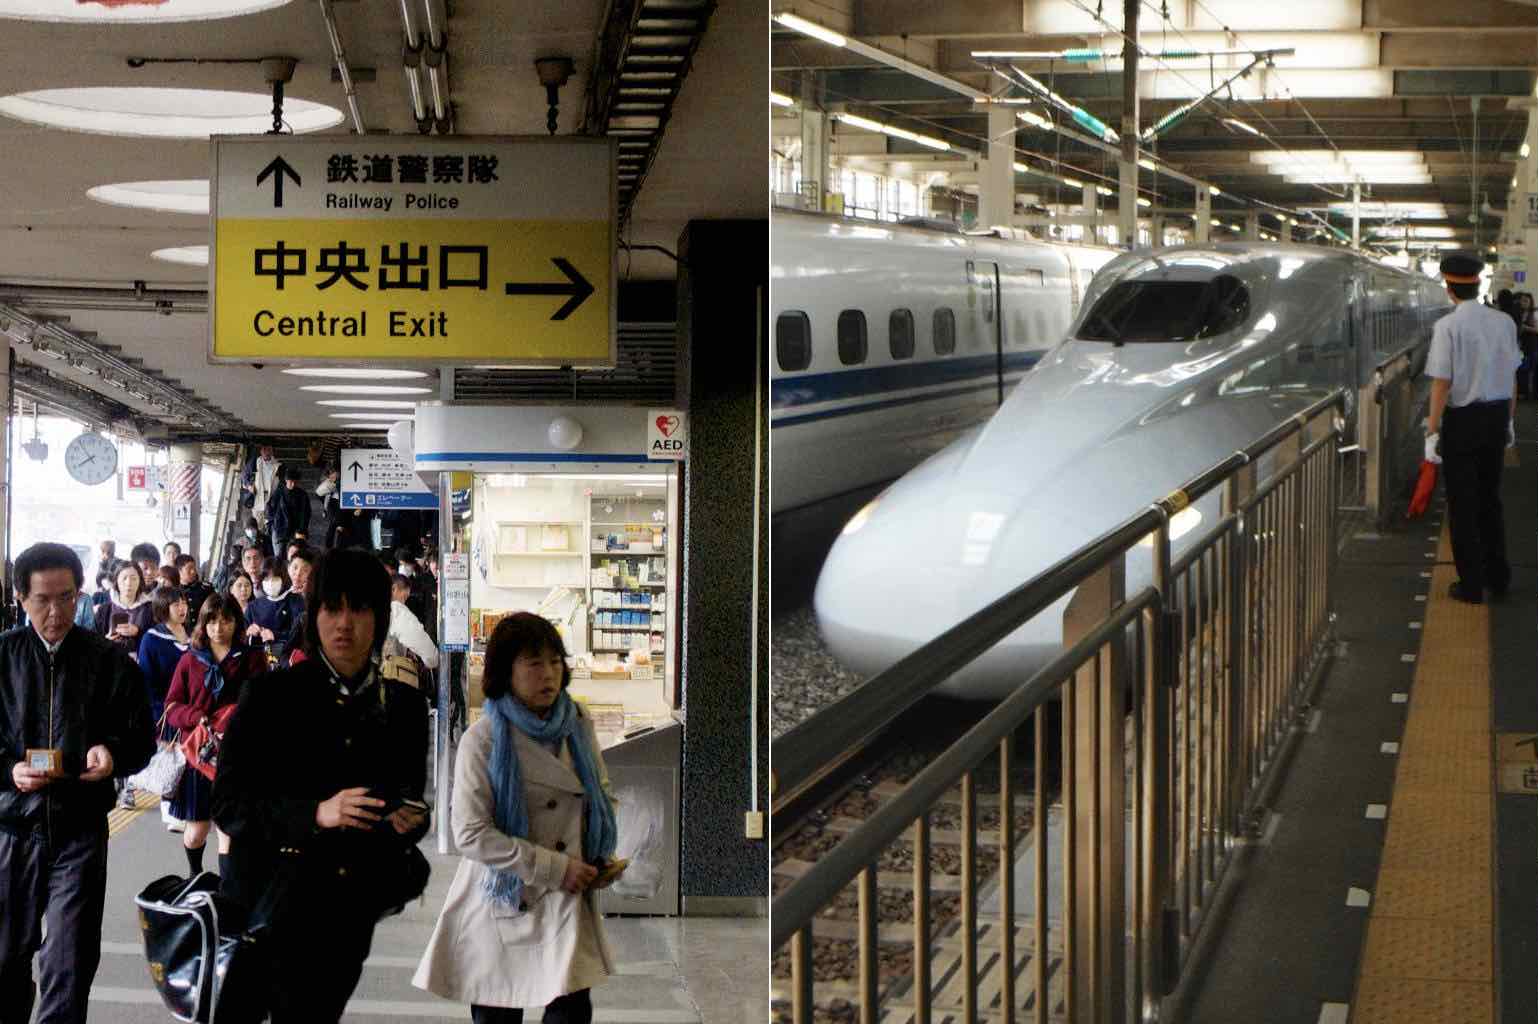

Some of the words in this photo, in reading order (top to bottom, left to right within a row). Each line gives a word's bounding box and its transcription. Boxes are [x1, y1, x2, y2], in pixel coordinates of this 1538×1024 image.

[326, 154, 499, 184] 鉄道警察隊
[326, 193, 393, 212] Railway
[405, 193, 459, 209] Police
[255, 240, 489, 291] 中央出口
[253, 310, 367, 337] Central
[389, 311, 448, 337] Exit
[652, 439, 683, 450] AED
